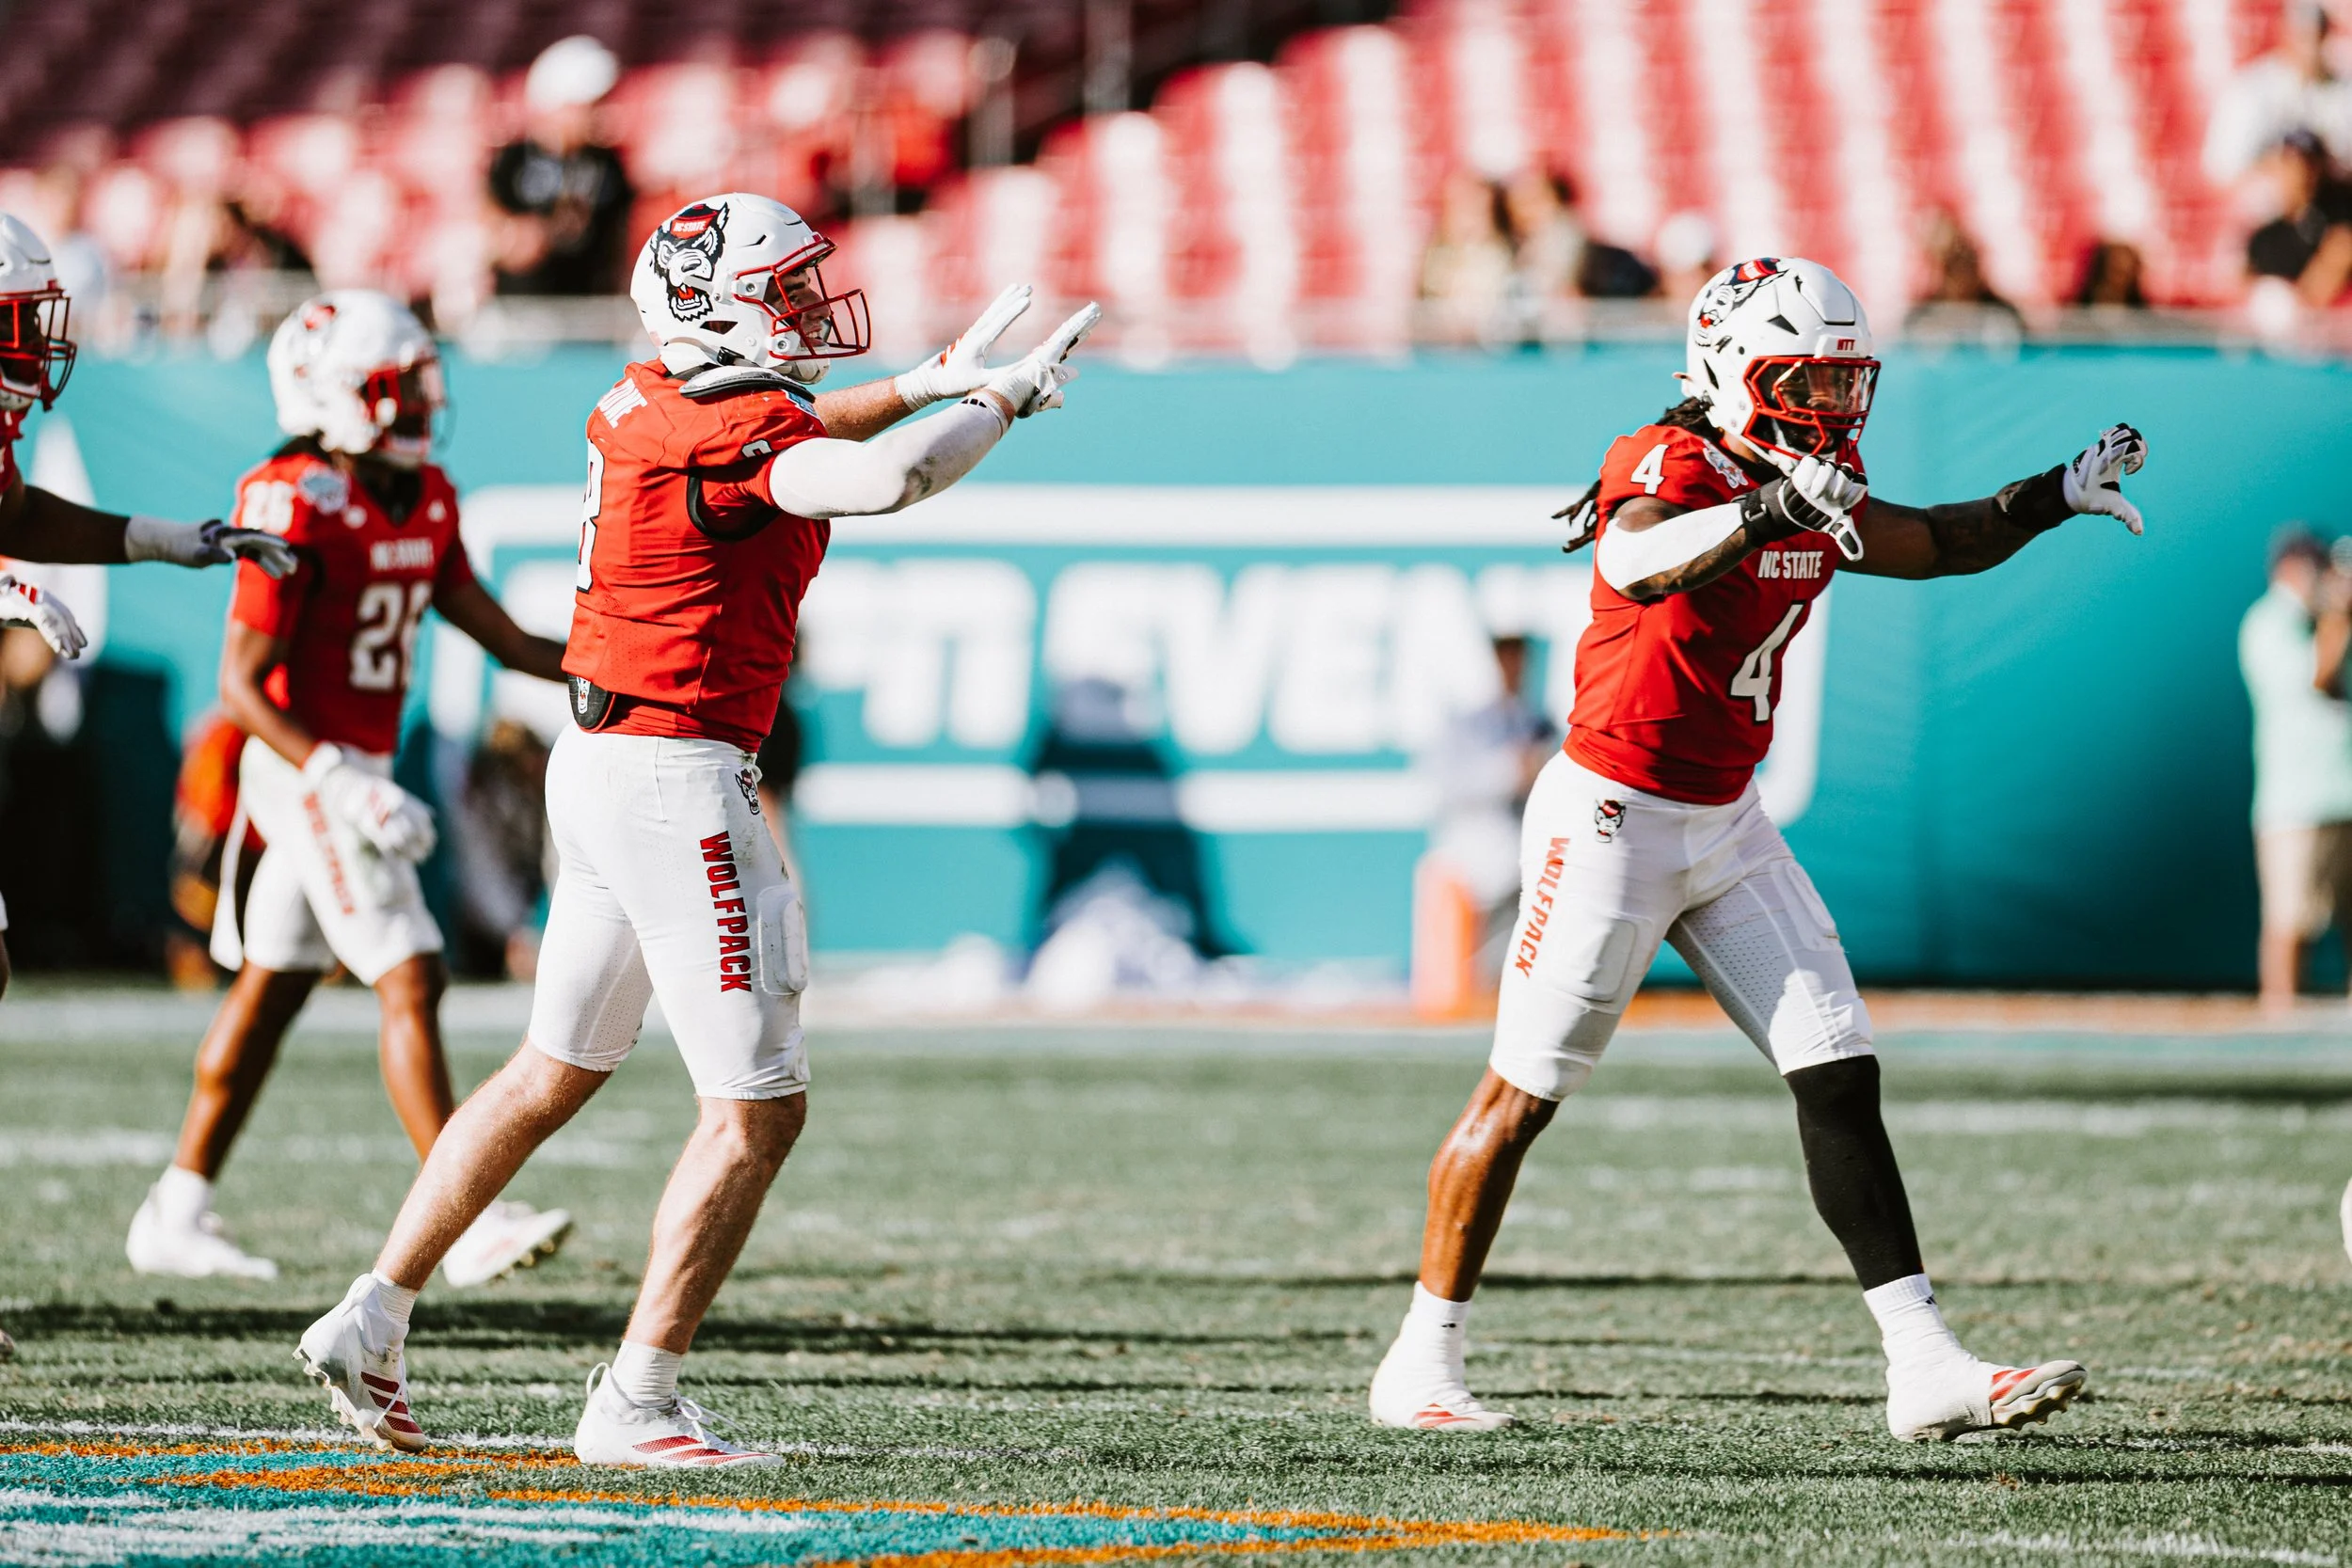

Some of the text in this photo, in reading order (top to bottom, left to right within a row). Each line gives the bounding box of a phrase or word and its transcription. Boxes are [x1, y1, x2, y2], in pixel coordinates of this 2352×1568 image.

[1630, 443, 1670, 495] 4
[1757, 550, 1824, 579] NC STATE
[1728, 600, 1805, 724] 4
[699, 830, 753, 993] WOLFPACK
[1515, 836, 1570, 979] WOLFPACK
